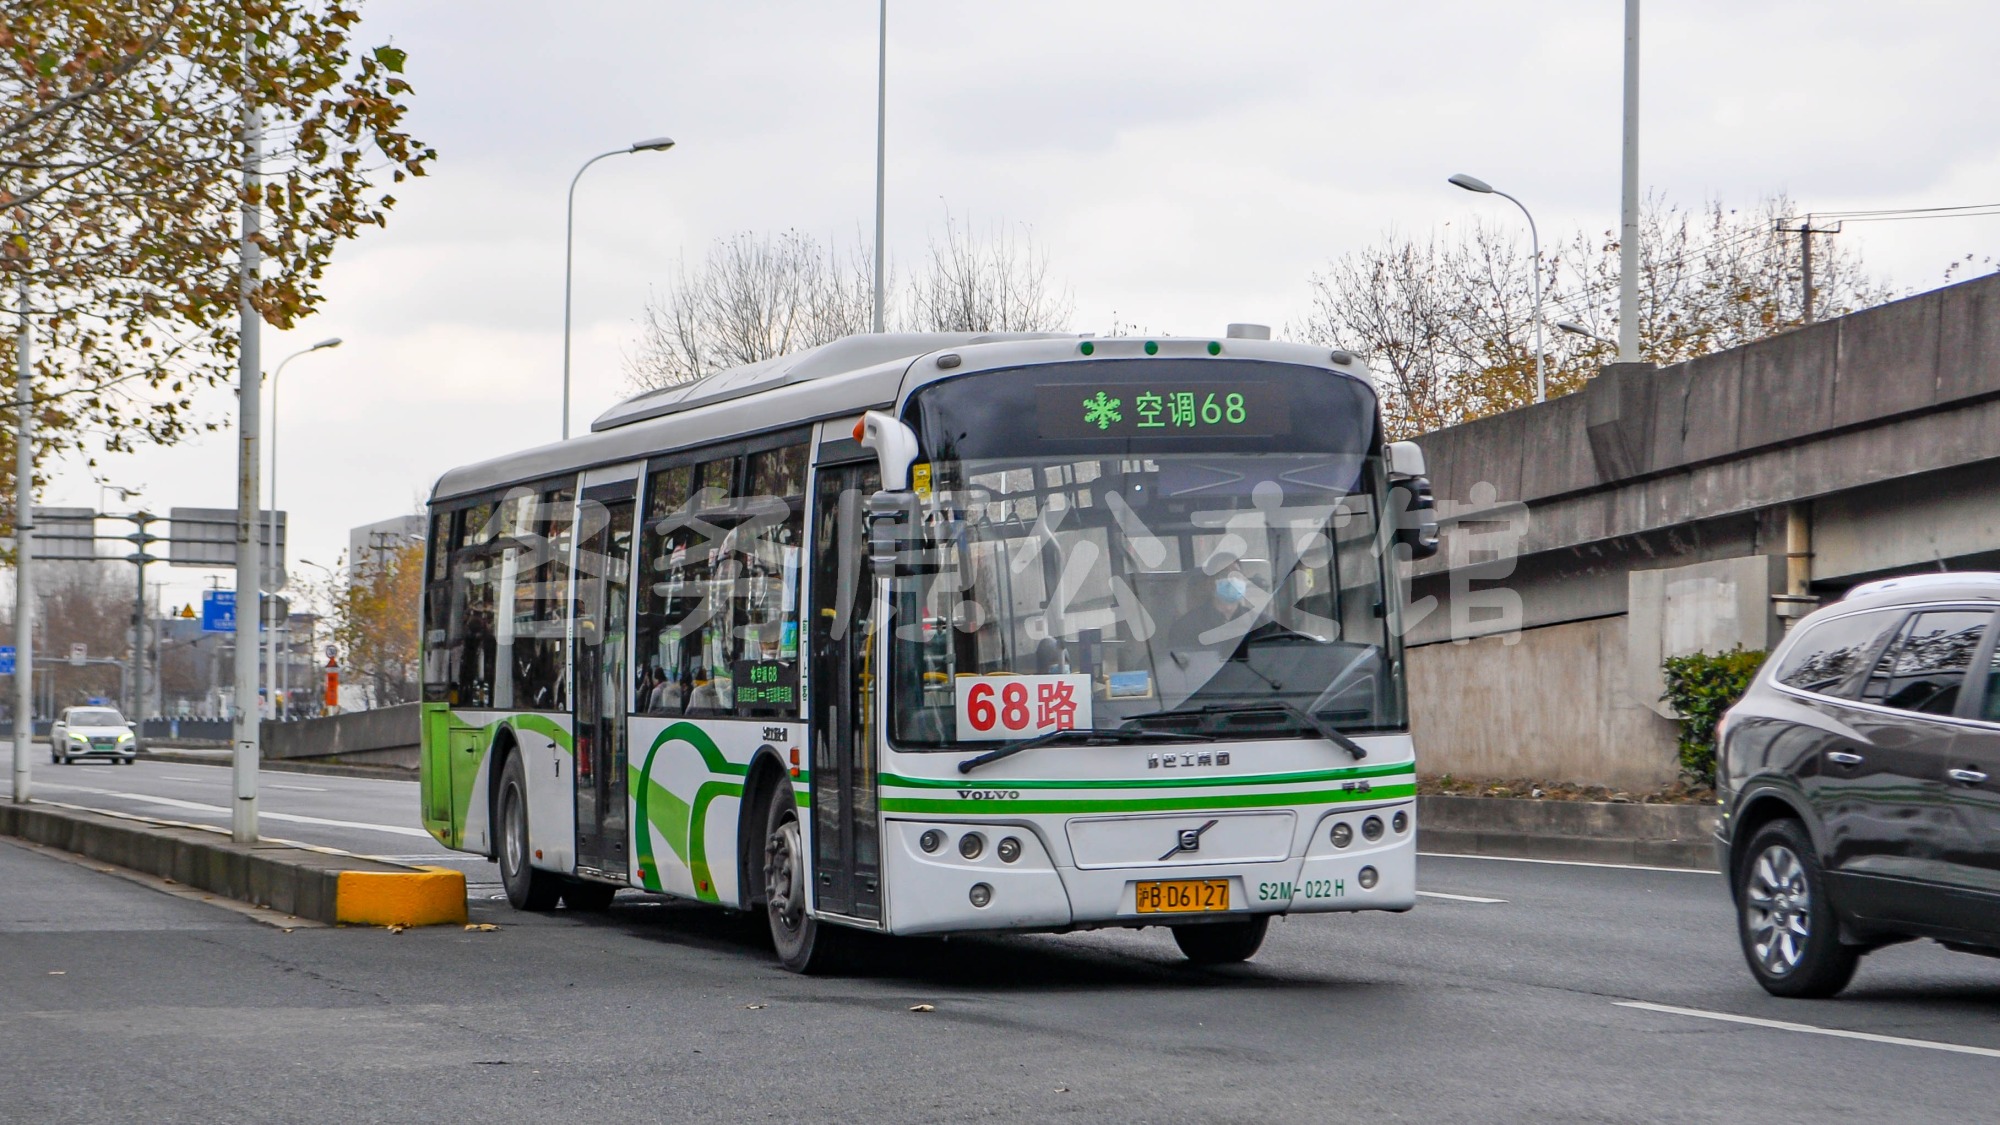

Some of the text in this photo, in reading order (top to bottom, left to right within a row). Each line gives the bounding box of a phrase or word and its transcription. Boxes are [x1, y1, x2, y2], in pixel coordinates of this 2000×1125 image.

[1136, 391, 1246, 427] 空调68
[967, 680, 1078, 732] 68路
[956, 790, 1020, 800] VOLVO
[1259, 879, 1344, 900] S2M-022H
